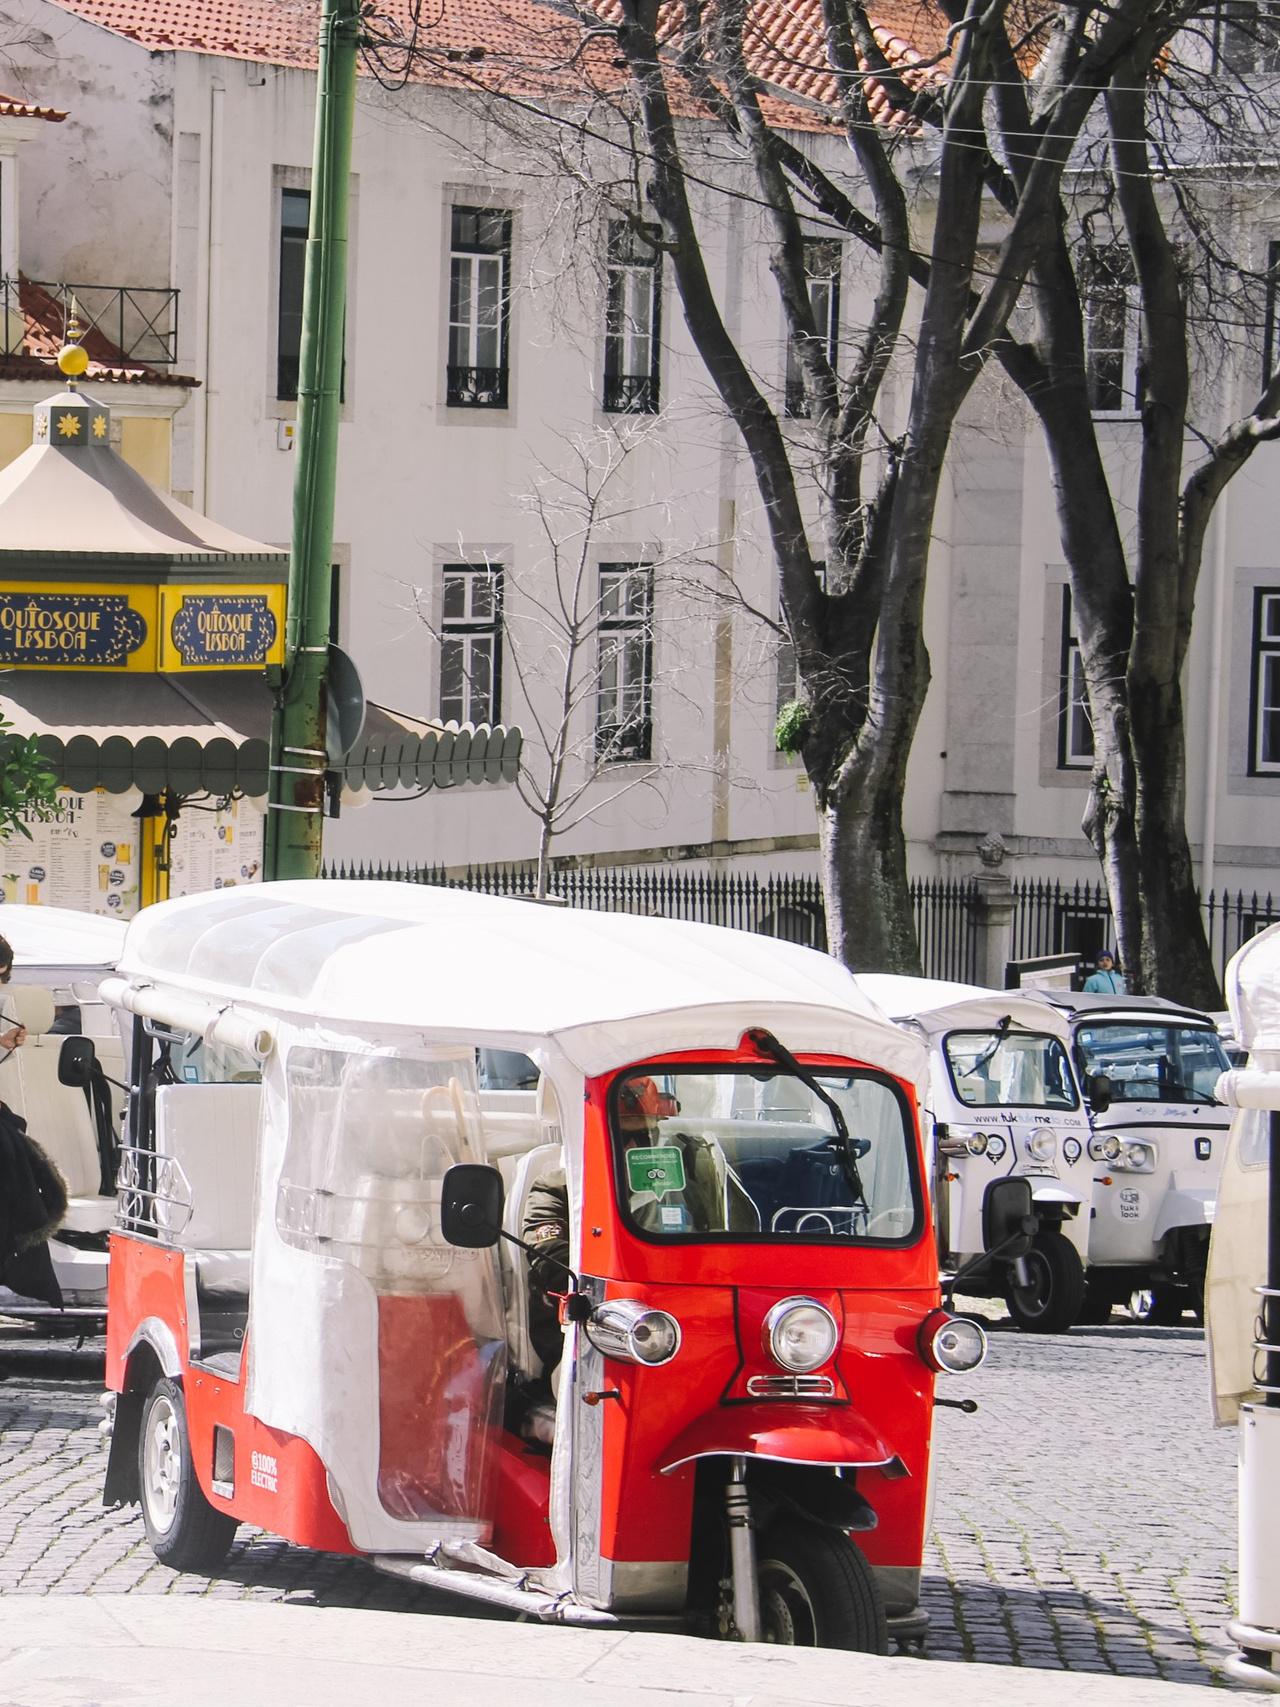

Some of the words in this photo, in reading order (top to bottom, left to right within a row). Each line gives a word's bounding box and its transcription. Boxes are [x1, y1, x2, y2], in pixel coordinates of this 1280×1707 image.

[0, 607, 100, 631] QUIOSQUE
[197, 610, 253, 633] QUIOSQUE
[251, 1469, 278, 1493] ELECTRIC
